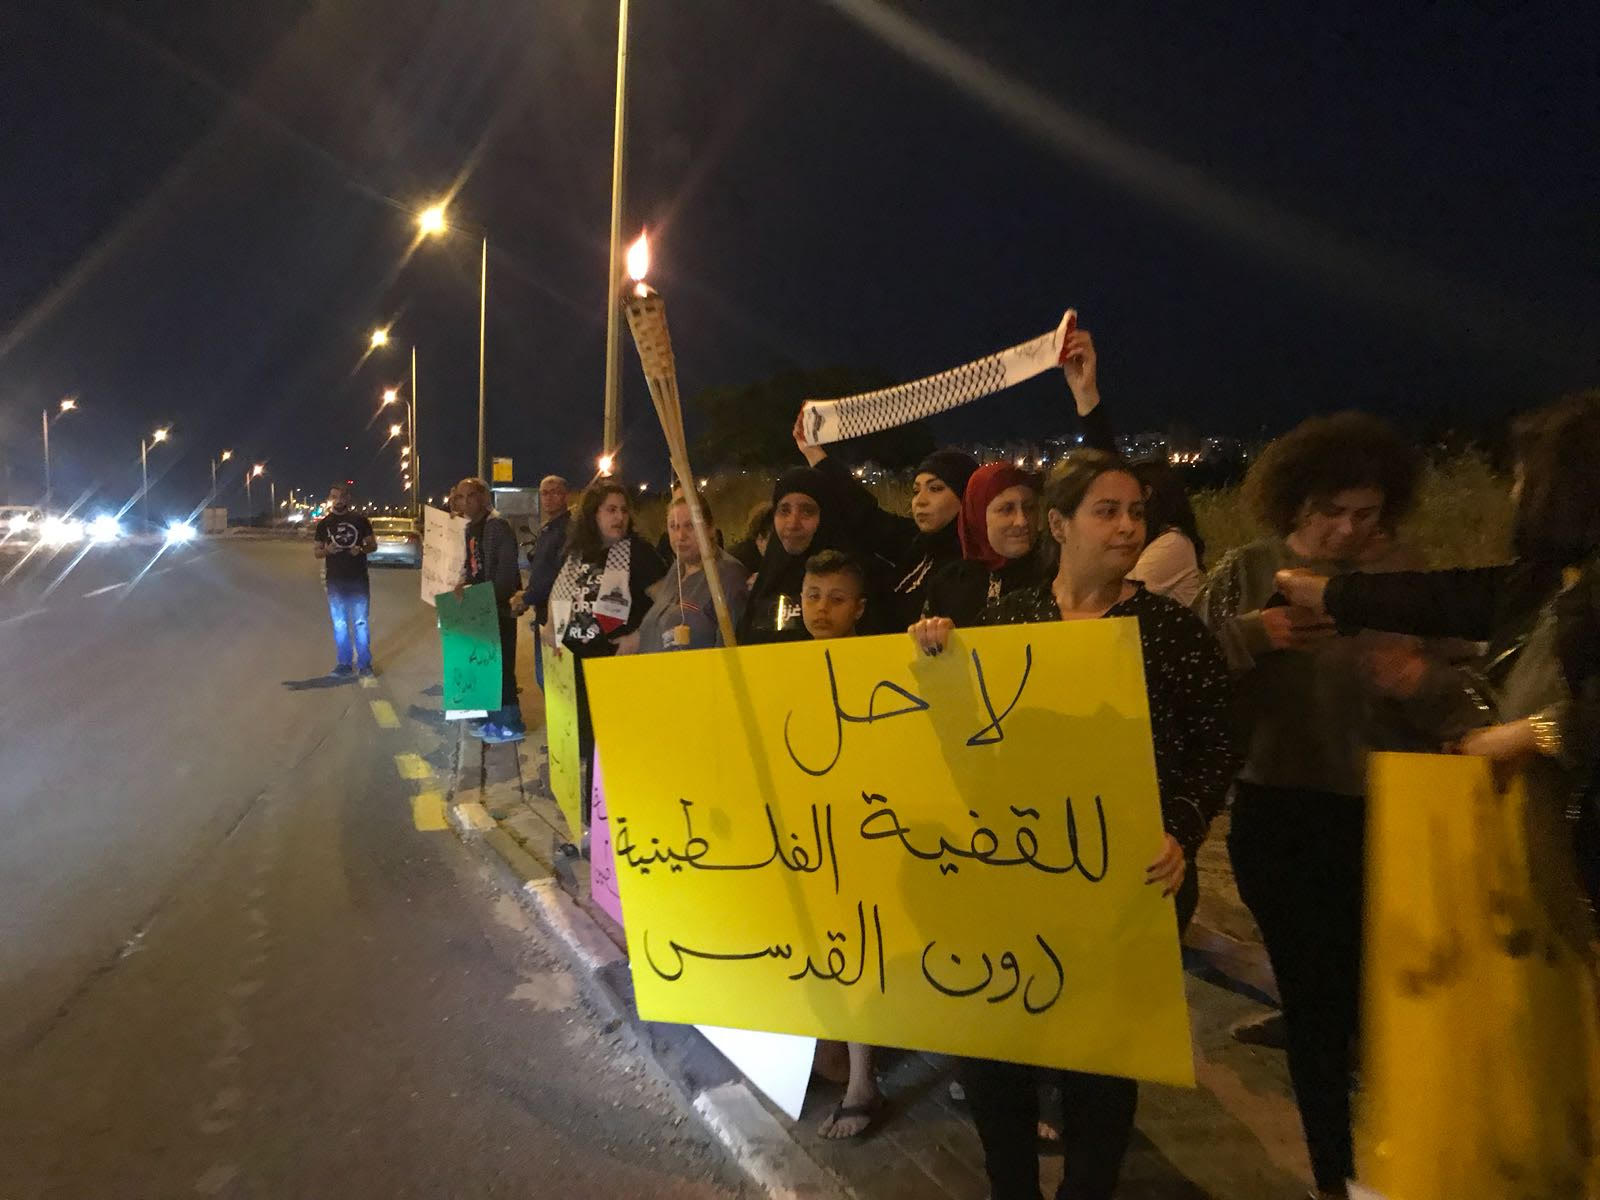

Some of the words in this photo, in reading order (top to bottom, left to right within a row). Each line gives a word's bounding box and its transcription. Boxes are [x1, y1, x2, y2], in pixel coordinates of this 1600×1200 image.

[784, 648, 930, 777] حل
[965, 643, 1032, 747] لا
[860, 790, 1108, 883] للقضية
[643, 900, 886, 995] القدس
[921, 934, 1064, 1014] دون
